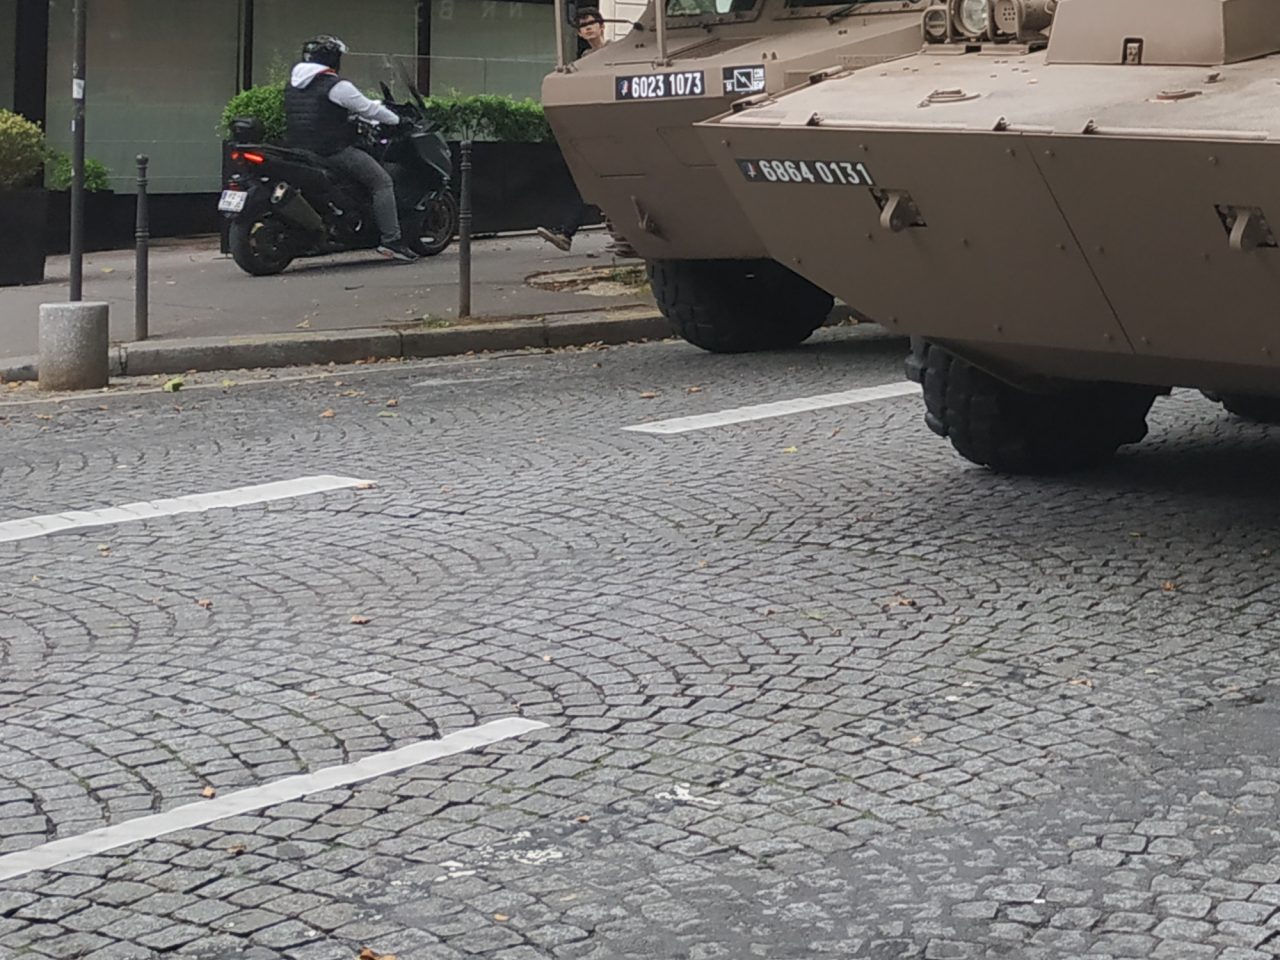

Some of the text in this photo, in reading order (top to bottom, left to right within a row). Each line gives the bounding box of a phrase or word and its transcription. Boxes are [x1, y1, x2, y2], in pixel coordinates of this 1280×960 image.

[631, 74, 665, 97] 6023
[669, 72, 702, 94] 1073
[759, 159, 873, 185] 6864 0131
